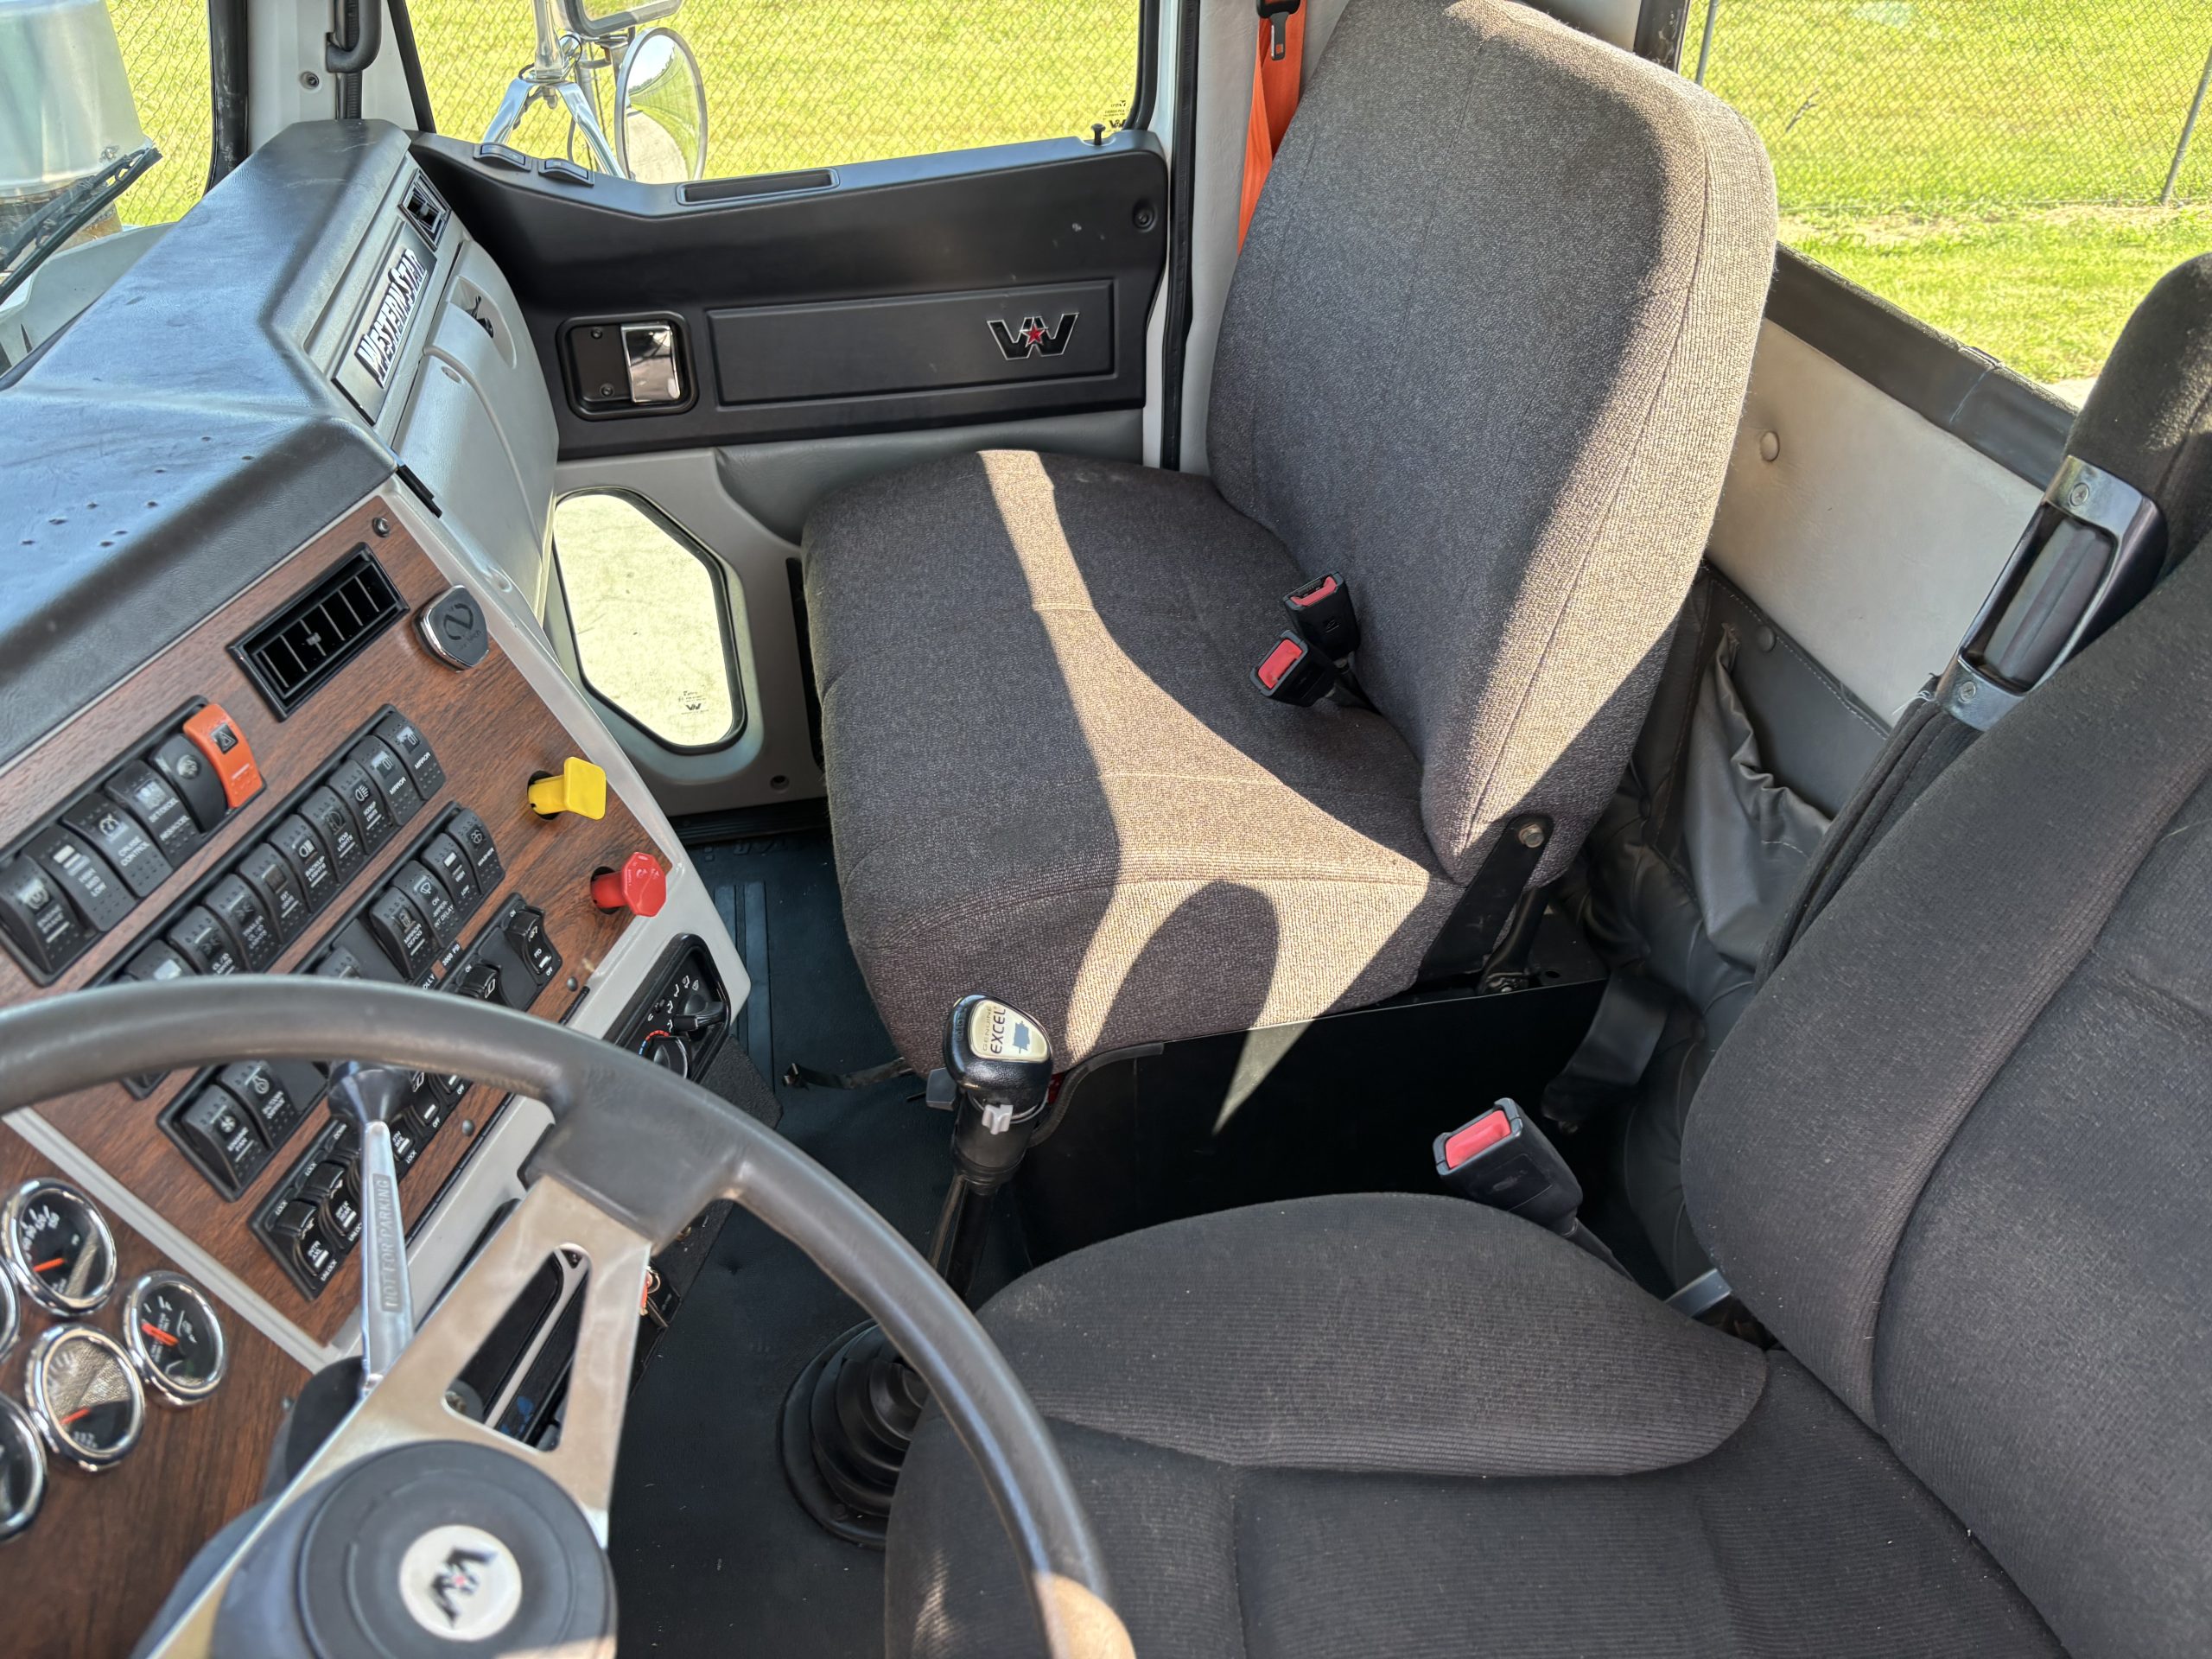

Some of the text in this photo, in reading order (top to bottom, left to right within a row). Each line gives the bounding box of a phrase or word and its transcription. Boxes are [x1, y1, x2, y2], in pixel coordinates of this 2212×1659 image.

[354, 248, 428, 382] WESTERN STAR
[414, 752, 431, 770] MIRROR
[390, 776, 407, 795] MIRROR
[337, 835, 353, 853] LIGHTS
[338, 831, 349, 843] FOG
[118, 836, 142, 857] CRUISE
[120, 841, 150, 867] CONTROL
[478, 847, 494, 867] WASHER
[305, 855, 326, 878] BACKUP
[308, 862, 327, 882] LIGHTS
[90, 881, 107, 898] LOW
[461, 885, 470, 896] LOW
[432, 897, 441, 906] ON
[441, 905, 454, 922] DELAY
[510, 909, 517, 918] ON
[404, 923, 423, 944] MIRROR
[407, 930, 423, 949] DEFOG
[442, 944, 461, 966] 3000 PSI
[534, 948, 543, 958] PTO
[423, 974, 435, 990] OLLY
[982, 1007, 992, 1052] GENUINE
[990, 1008, 1006, 1054] EXCEL
[432, 1116, 441, 1128] OFF
[334, 1123, 347, 1140] DOWN
[405, 1150, 417, 1164] LOCK
[304, 1162, 317, 1177] LOCK
[275, 1200, 288, 1216] LOCK
[348, 1222, 363, 1242] UNLOC
[377, 1180, 398, 1306] NOT FOR PARKING
[321, 1259, 338, 1281] UNLOCK
